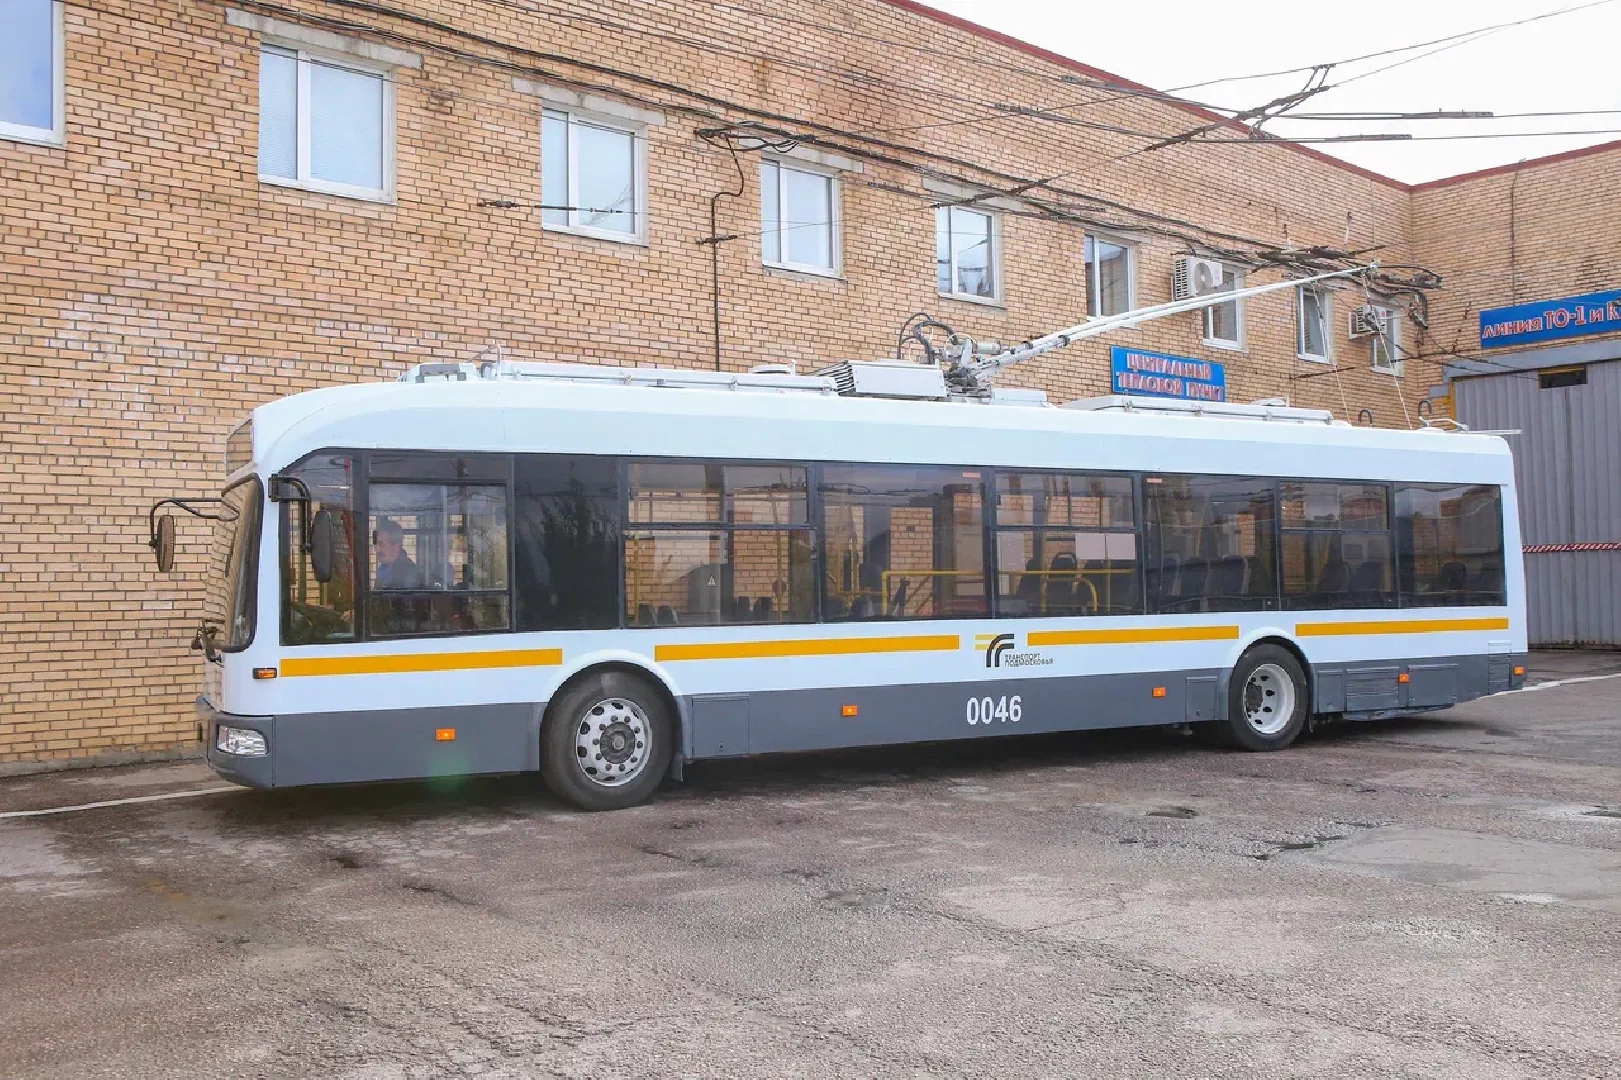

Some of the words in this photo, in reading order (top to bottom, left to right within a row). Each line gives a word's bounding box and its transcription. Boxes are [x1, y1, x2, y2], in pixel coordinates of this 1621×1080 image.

[1544, 305, 1586, 330] ТО-1
[1127, 353, 1211, 380] ЦЕНТРАЛЬНЫЙ
[1116, 371, 1183, 395] ТЕПЛОВОЙ
[1004, 653, 1040, 661] ТРАНСПОРТ
[966, 695, 1022, 725] 0046
